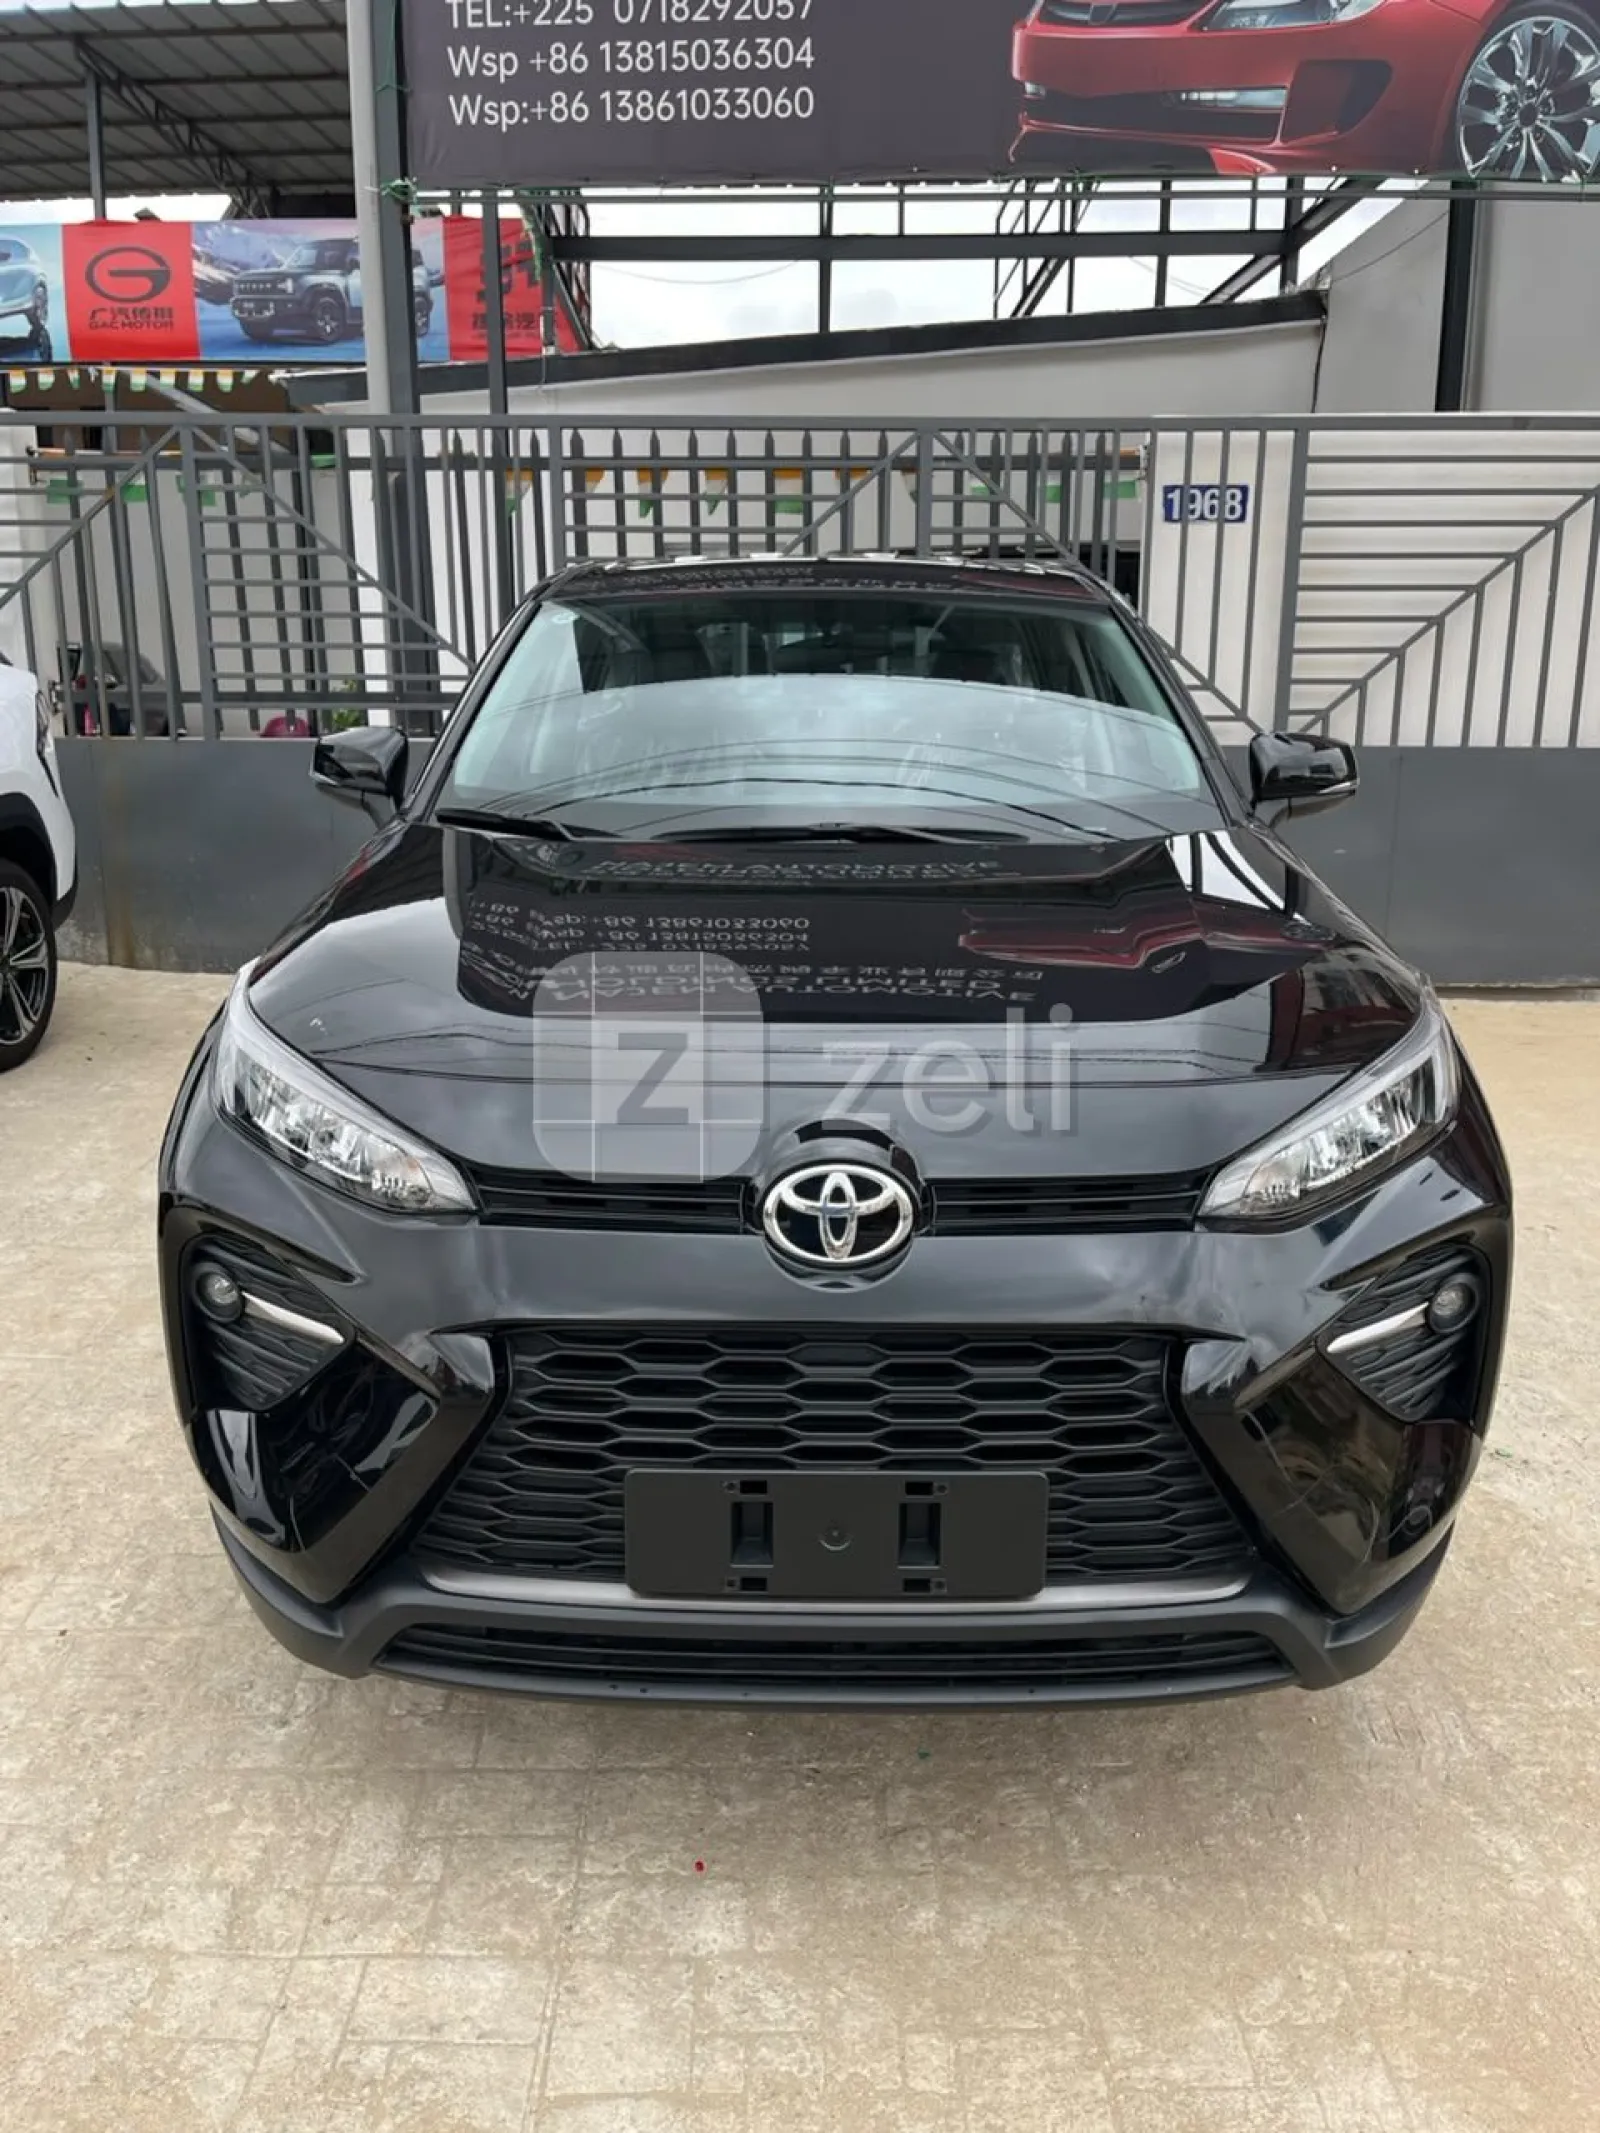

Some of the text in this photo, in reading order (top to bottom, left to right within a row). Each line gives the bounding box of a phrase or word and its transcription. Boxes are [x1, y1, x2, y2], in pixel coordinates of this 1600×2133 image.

[444, 0, 812, 29] TEL:+225 0718292057
[447, 36, 815, 84] Wsp +86 13815036304
[448, 86, 814, 133] Wsp:+86 13861033060
[1167, 488, 1242, 520] 1968
